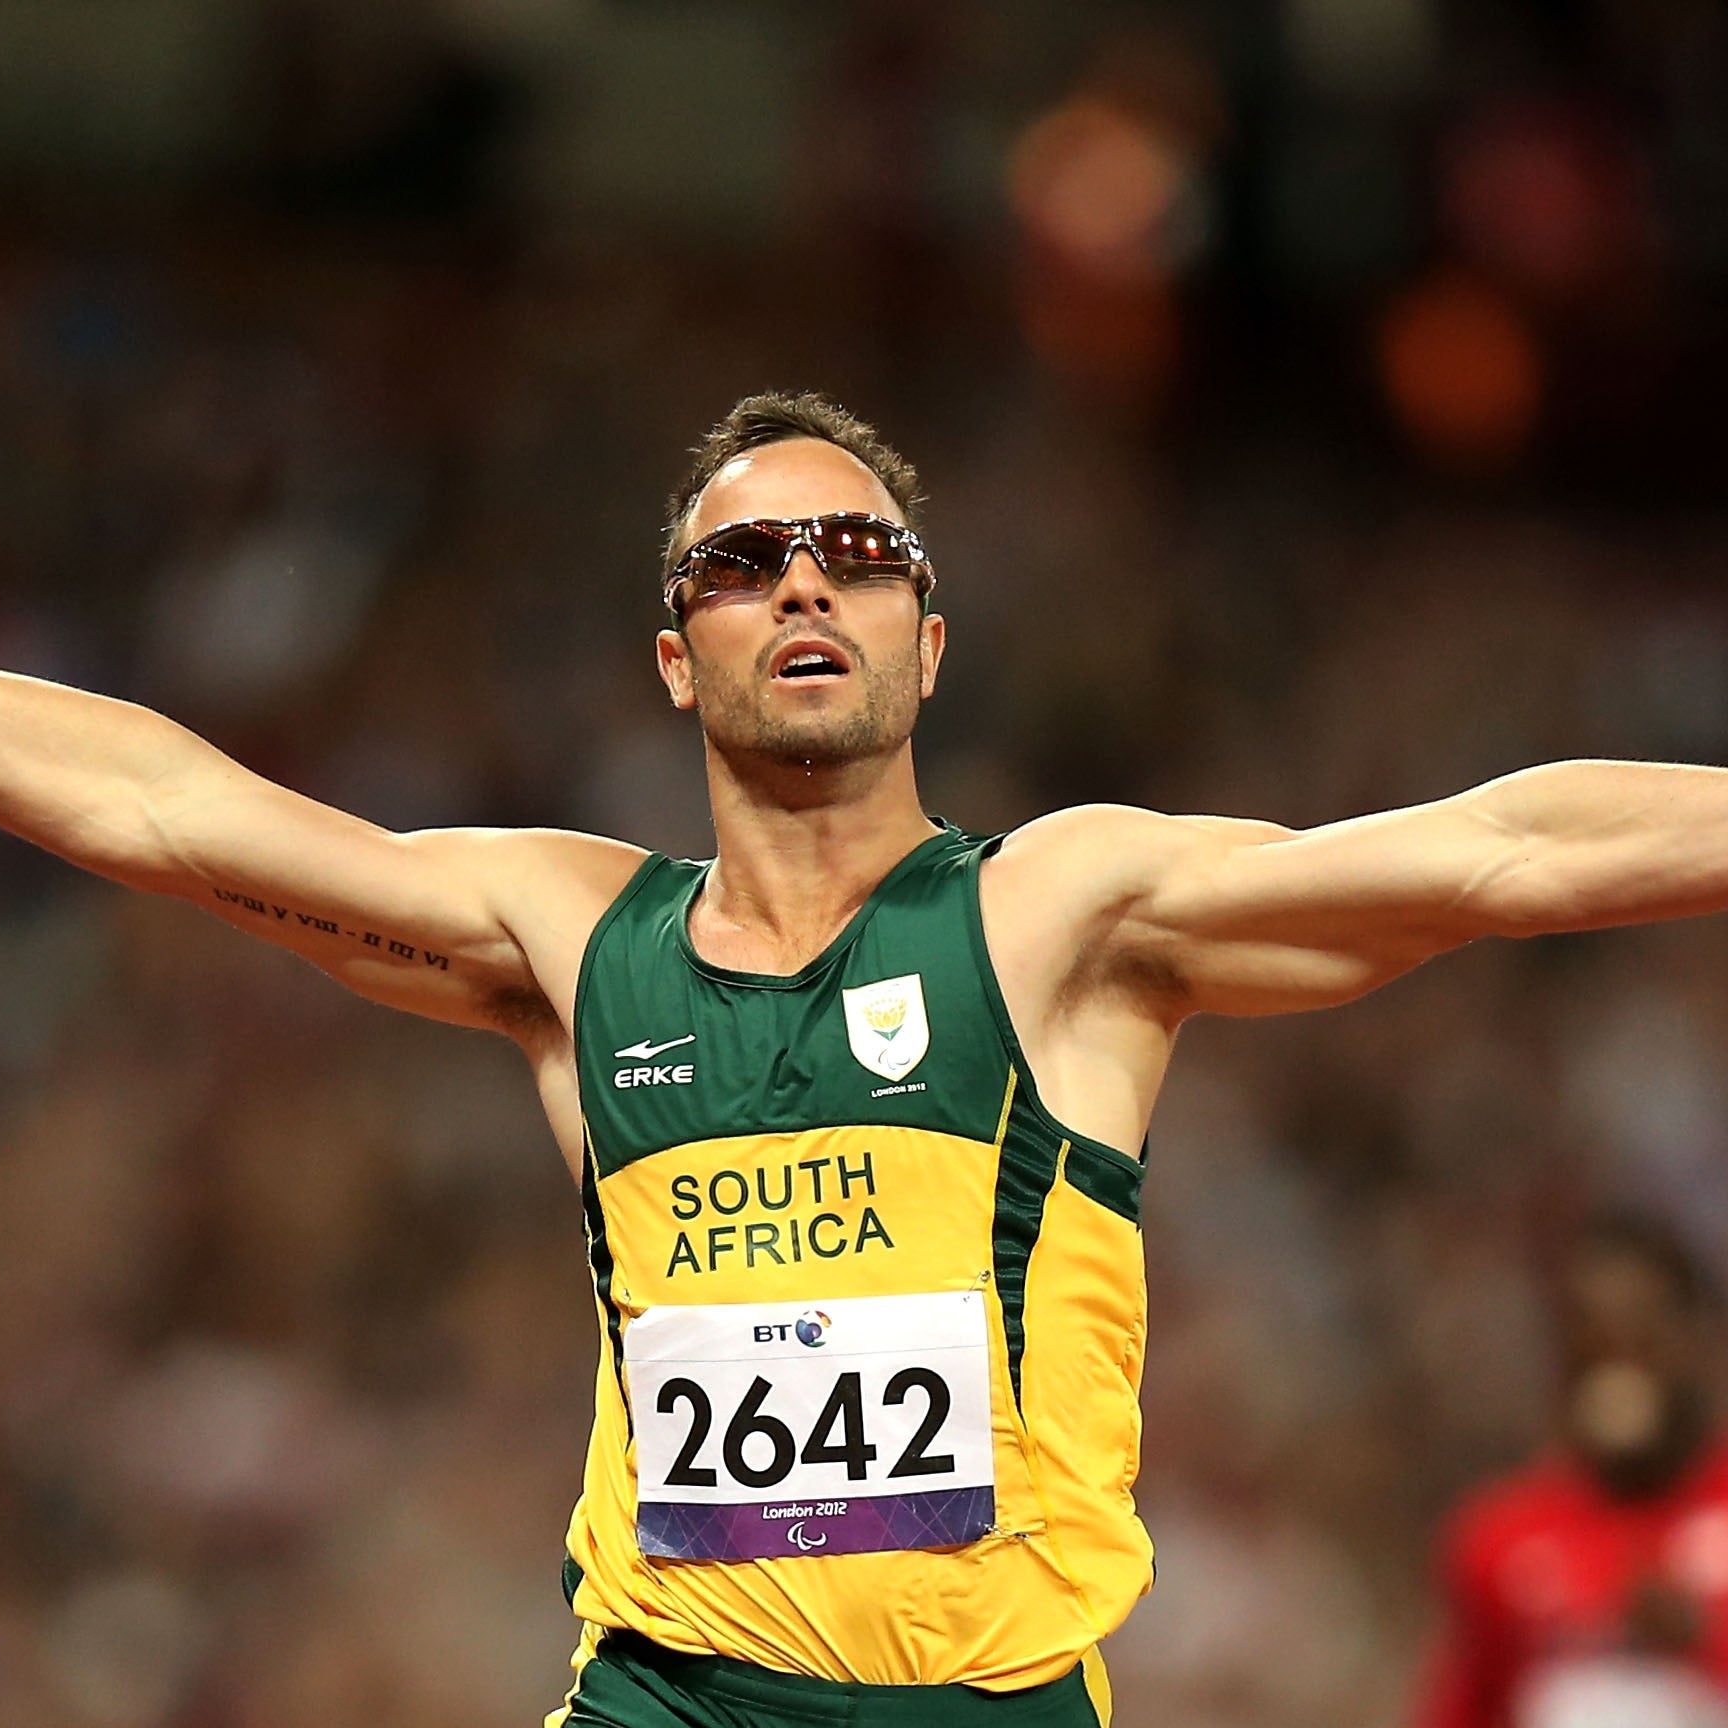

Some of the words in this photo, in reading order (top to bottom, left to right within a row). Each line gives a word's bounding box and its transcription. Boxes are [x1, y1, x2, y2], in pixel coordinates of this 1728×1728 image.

[271, 904, 288, 920] V
[362, 931, 381, 947] II
[388, 939, 416, 960] III
[423, 950, 449, 971] VI
[614, 1064, 694, 1089] ERKE
[871, 1085, 906, 1098] LONDON
[670, 1151, 877, 1220] SOUTH
[665, 1206, 894, 1278] AFRICA
[754, 1323, 793, 1343] BT
[656, 1366, 956, 1489] 2642
[762, 1503, 813, 1519] London
[815, 1502, 848, 1516] 2012
